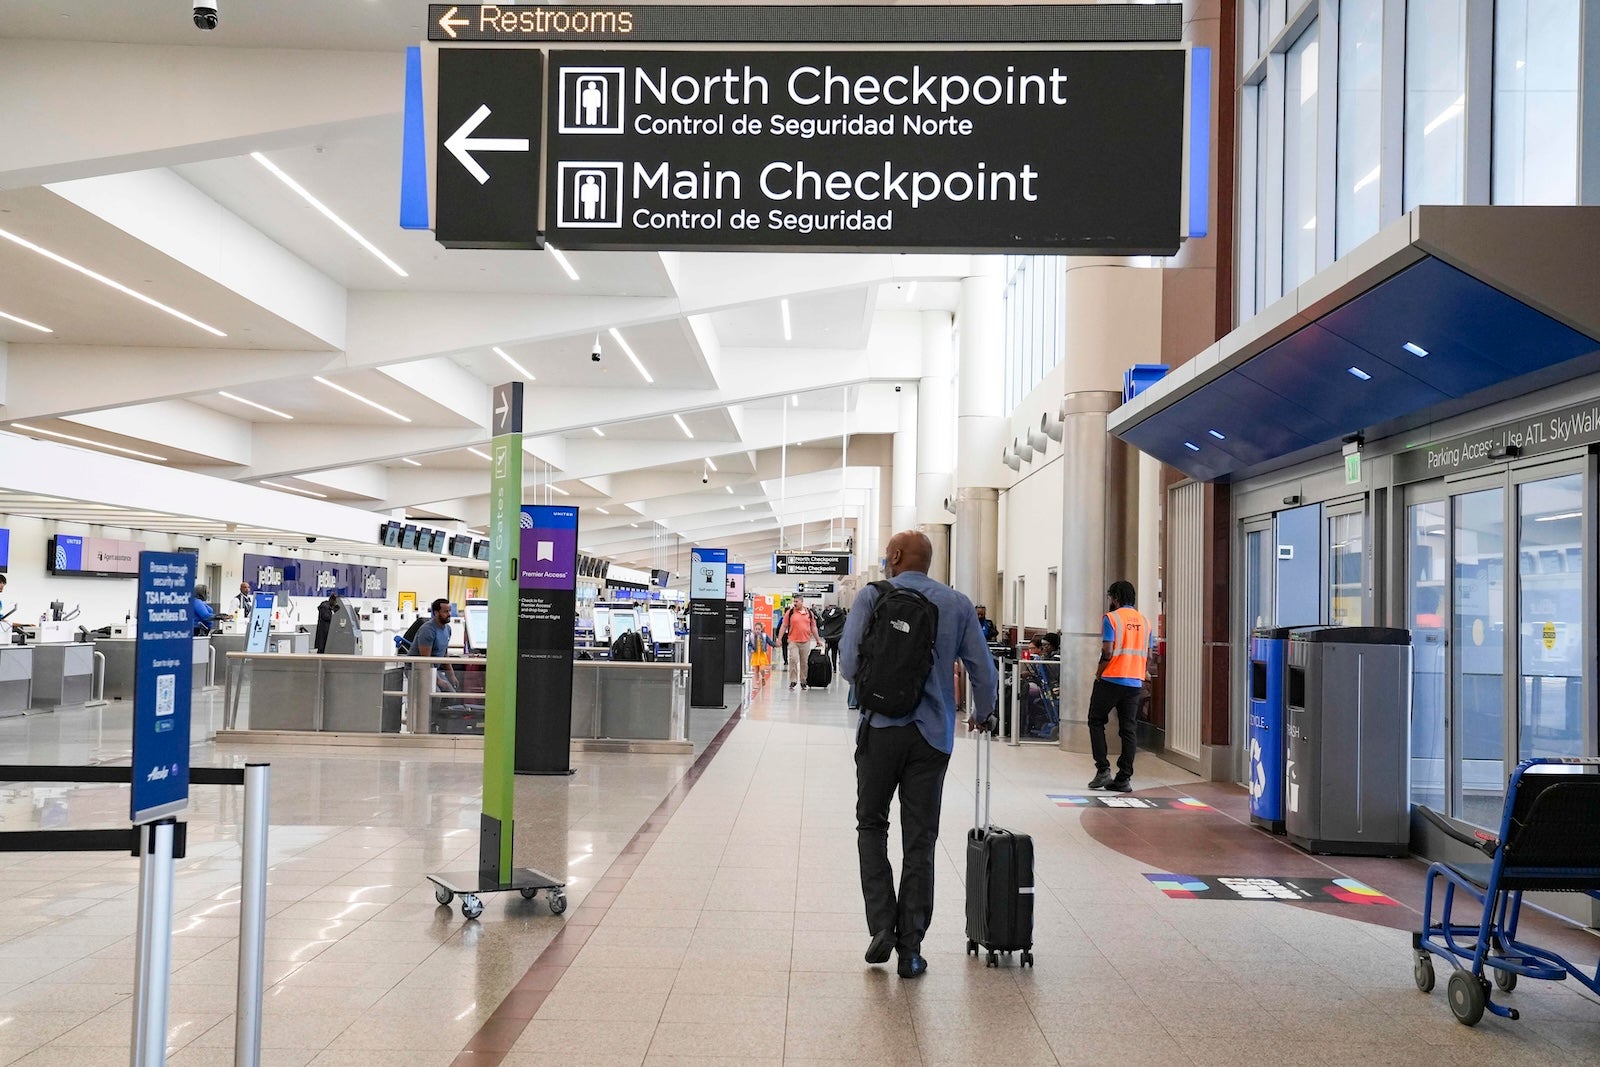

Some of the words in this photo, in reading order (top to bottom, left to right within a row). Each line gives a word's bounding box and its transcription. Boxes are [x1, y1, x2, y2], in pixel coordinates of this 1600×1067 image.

[480, 5, 633, 32] Restrooms
[635, 66, 768, 104] North
[788, 66, 1067, 111] Checkpoint
[635, 114, 723, 134] Control
[732, 114, 762, 134] de
[770, 114, 894, 138] Seguridad
[904, 115, 972, 135] Norte
[633, 162, 740, 199] Main
[760, 161, 1038, 208] Checkpoint
[633, 209, 721, 229] Control
[730, 209, 760, 229] de
[768, 210, 892, 233] Seguridad
[1428, 446, 1460, 469] Parking
[1461, 440, 1493, 461] Access
[1503, 430, 1522, 448] Use
[1525, 423, 1547, 446] ATL
[1550, 408, 1600, 441] SkyWalk
[495, 487, 504, 550] Gates
[104, 553, 114, 562] Agent
[257, 565, 282, 589] jetBlue
[316, 569, 336, 592] jetBlue
[364, 573, 381, 593] jetBlue
[145, 591, 159, 604] TSA
[148, 609, 178, 622] Touchless
